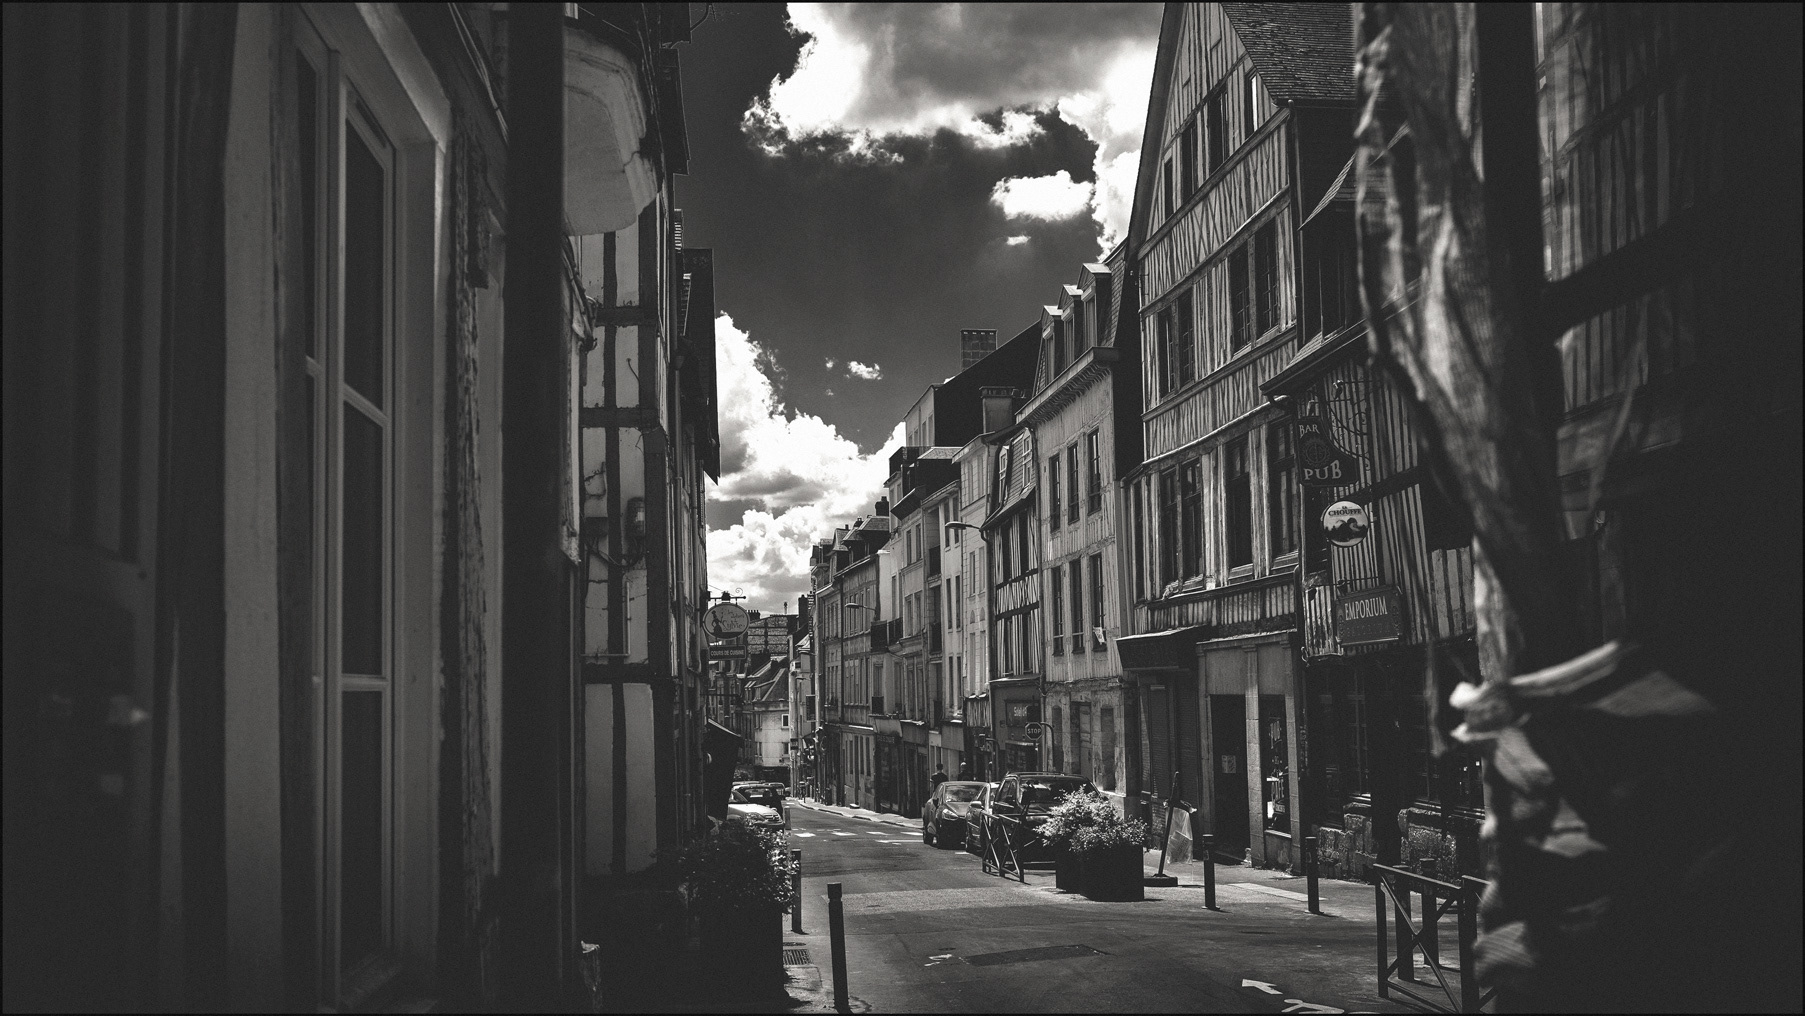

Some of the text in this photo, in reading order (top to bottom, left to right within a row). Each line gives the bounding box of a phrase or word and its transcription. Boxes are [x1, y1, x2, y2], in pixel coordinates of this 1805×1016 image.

[1299, 424, 1320, 439] BAR
[1303, 460, 1342, 480] PUB
[1328, 508, 1363, 517] CHOUFFE
[1344, 596, 1388, 620] EMPORIUM
